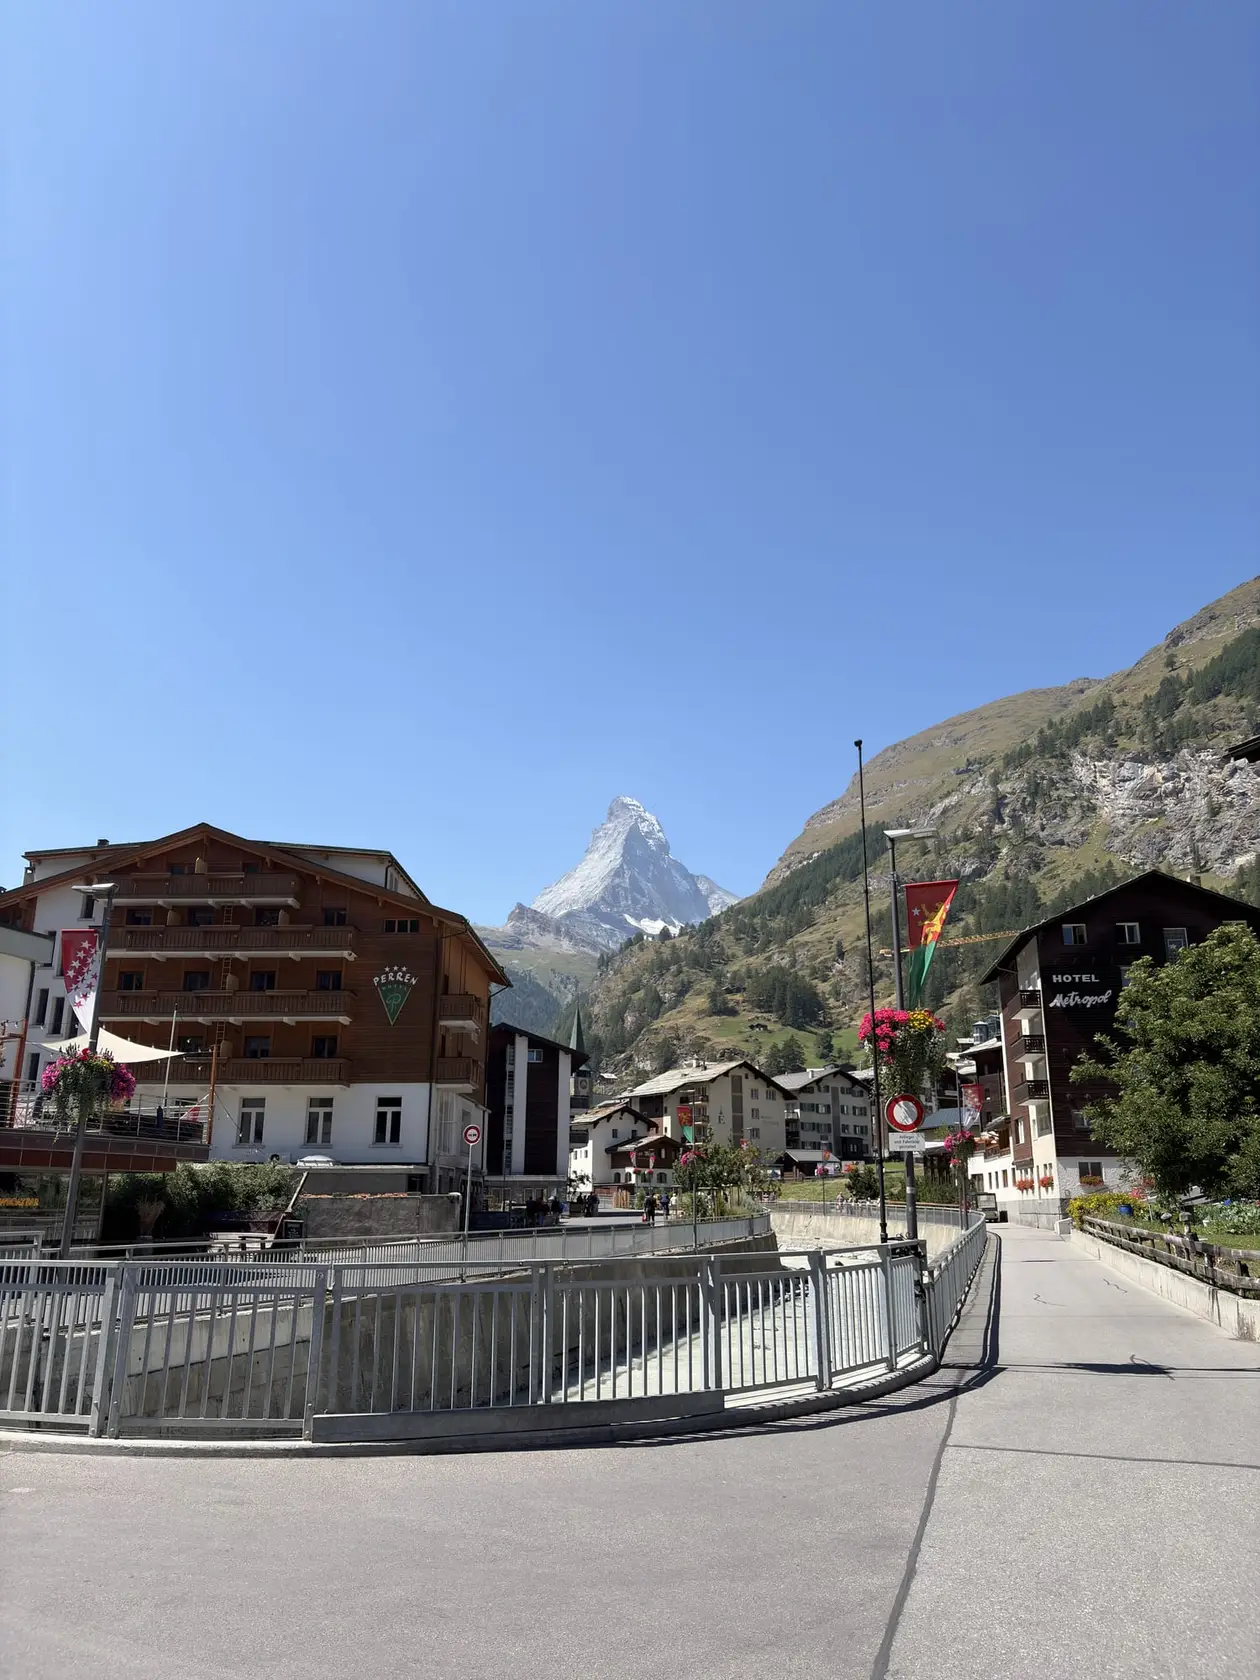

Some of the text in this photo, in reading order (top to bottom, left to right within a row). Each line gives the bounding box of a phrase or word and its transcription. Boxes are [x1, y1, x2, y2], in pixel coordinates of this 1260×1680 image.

[373, 972, 418, 986] PERREN
[1052, 974, 1100, 983] HOTEL
[1049, 990, 1112, 1008] Metropol
